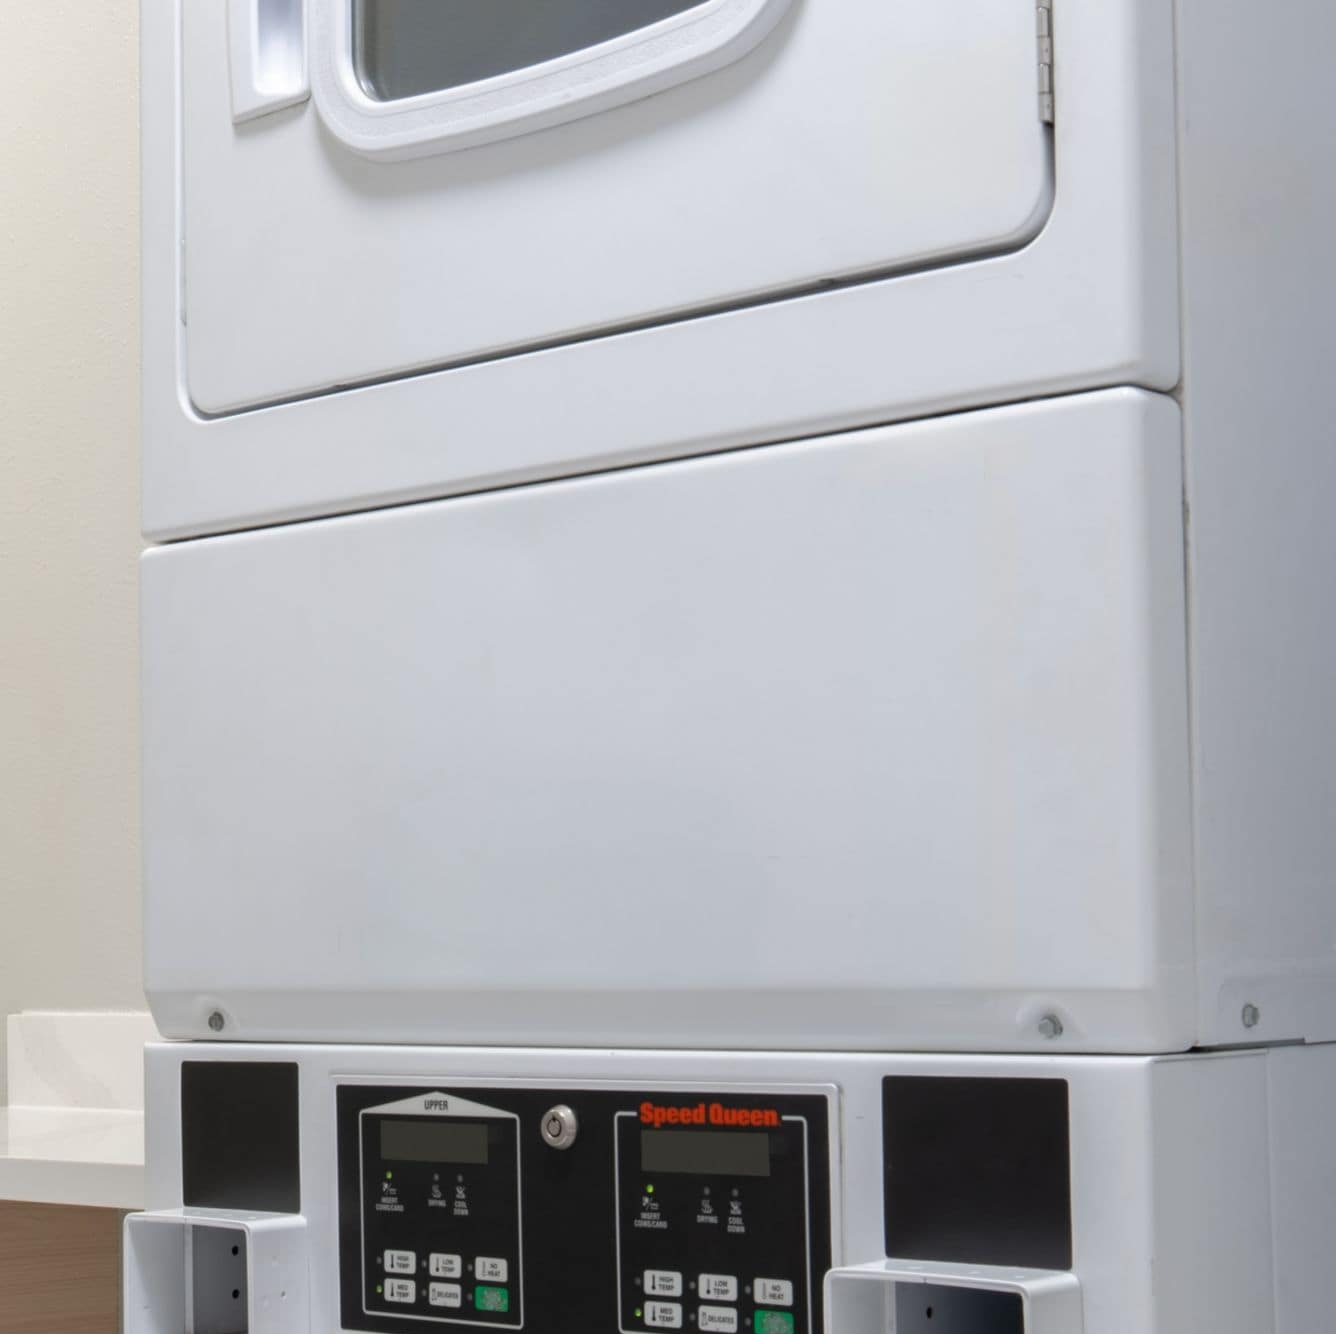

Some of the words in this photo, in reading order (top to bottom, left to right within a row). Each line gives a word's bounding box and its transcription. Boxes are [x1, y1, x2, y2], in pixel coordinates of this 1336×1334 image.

[424, 1099, 449, 1111] UPPER
[640, 1101, 705, 1128] Speed
[709, 1102, 779, 1127] Queen
[441, 1258, 455, 1266] LOW
[658, 1283, 675, 1291] TEMP
[714, 1280, 729, 1288] LOW
[713, 1288, 730, 1296] TEMP
[768, 1292, 785, 1300] HEAT
[659, 1307, 674, 1315] MED
[707, 1315, 735, 1324] DELICATES
